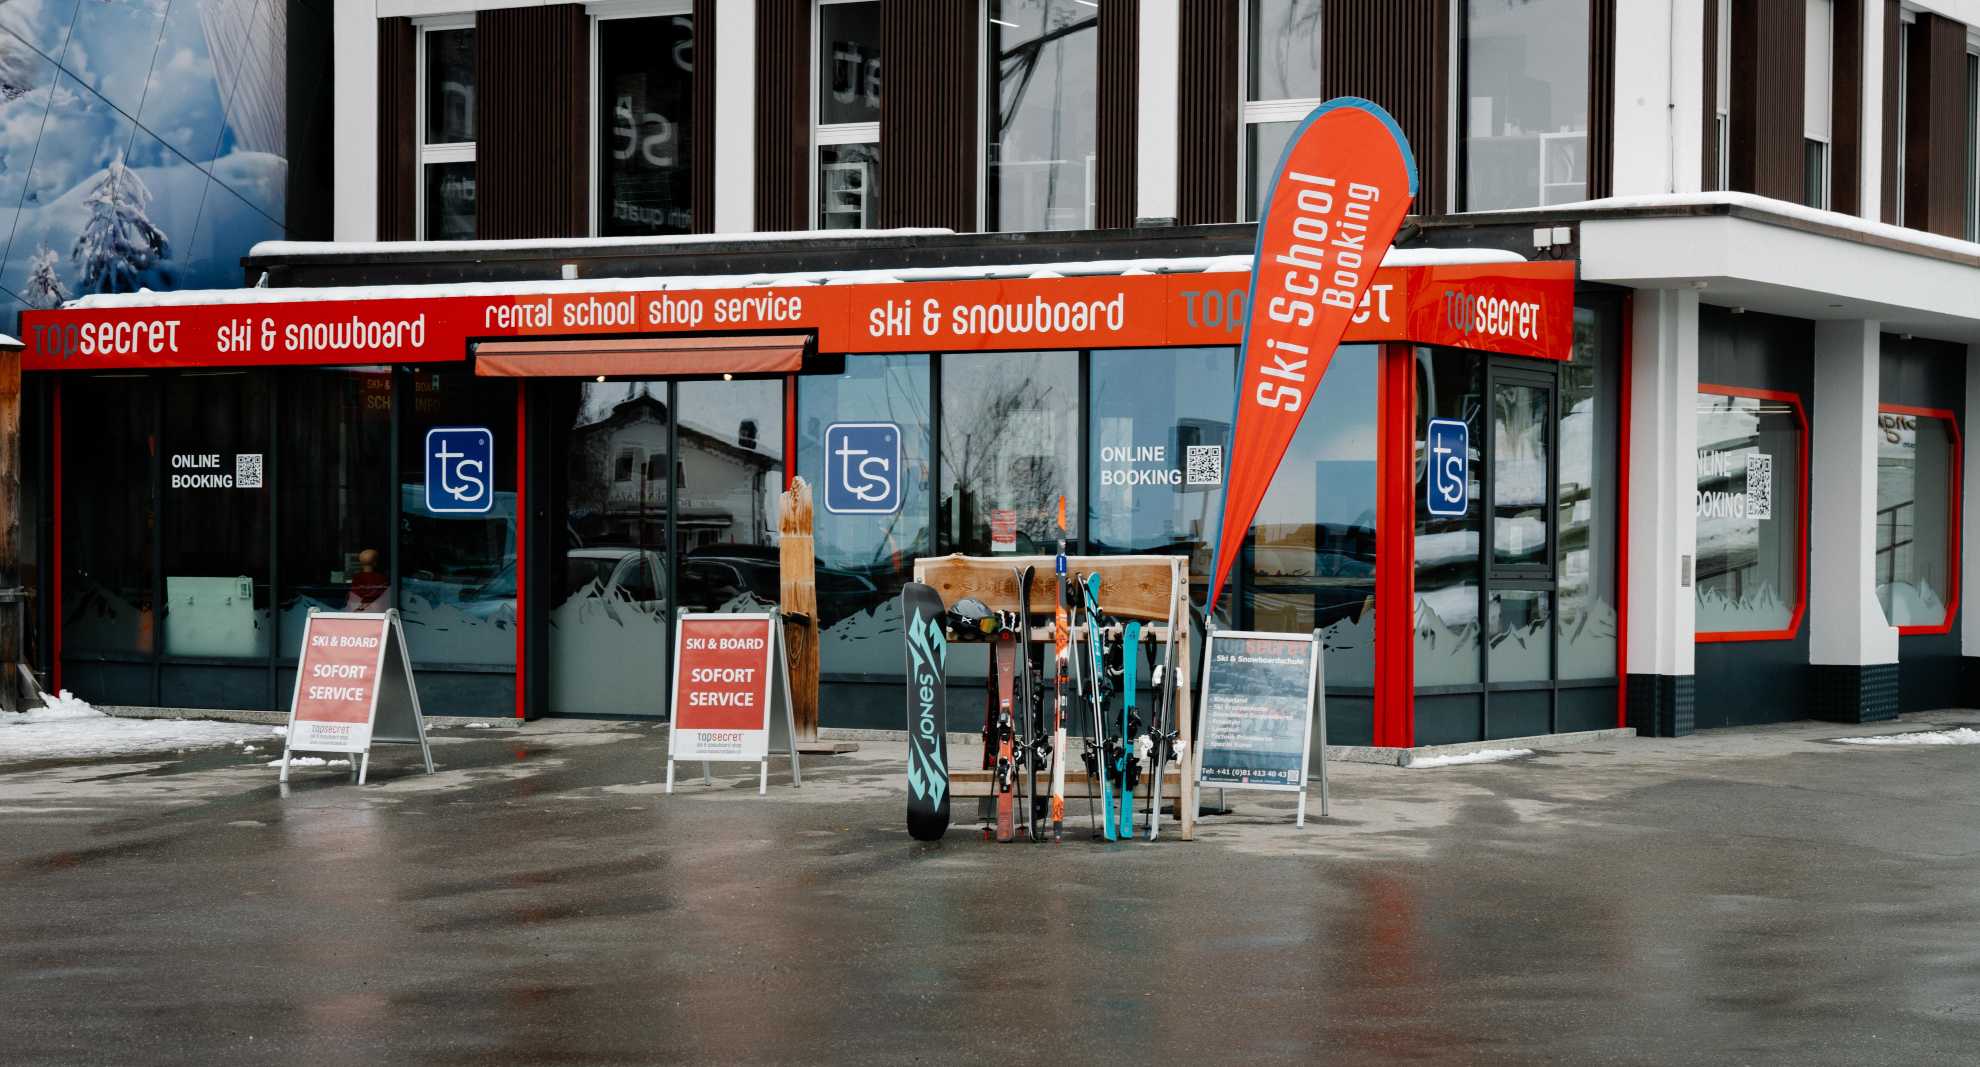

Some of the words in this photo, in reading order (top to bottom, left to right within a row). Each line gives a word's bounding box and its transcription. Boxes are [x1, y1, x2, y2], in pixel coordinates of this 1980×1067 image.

[1269, 171, 1336, 327] School
[1321, 182, 1379, 310] Booking
[485, 298, 552, 328] rental
[563, 296, 635, 327] school
[649, 295, 703, 327] shop
[714, 291, 801, 322] service
[869, 299, 911, 337] ski
[923, 298, 941, 336] &
[952, 293, 1124, 335] snowboard
[217, 317, 252, 353] ski
[261, 319, 277, 351] &
[285, 313, 425, 351] snowboard
[1257, 339, 1310, 412] Ski
[172, 454, 220, 469] ONLINE
[1101, 446, 1165, 462] ONLINE
[1697, 449, 1732, 477] NLINE
[172, 474, 233, 489] BOOKING
[1101, 469, 1182, 486] BOOKING
[1696, 490, 1744, 517] OOKING
[312, 635, 329, 647] SKI
[330, 636, 338, 647] &
[340, 636, 378, 648] BOARD
[686, 638, 705, 650] SKI
[708, 638, 717, 650] &
[720, 638, 764, 650] BOARD
[313, 664, 367, 679] SOFORT
[691, 668, 755, 682] SOFORT
[309, 686, 364, 701] SERVICE
[689, 692, 754, 706] SERVICE
